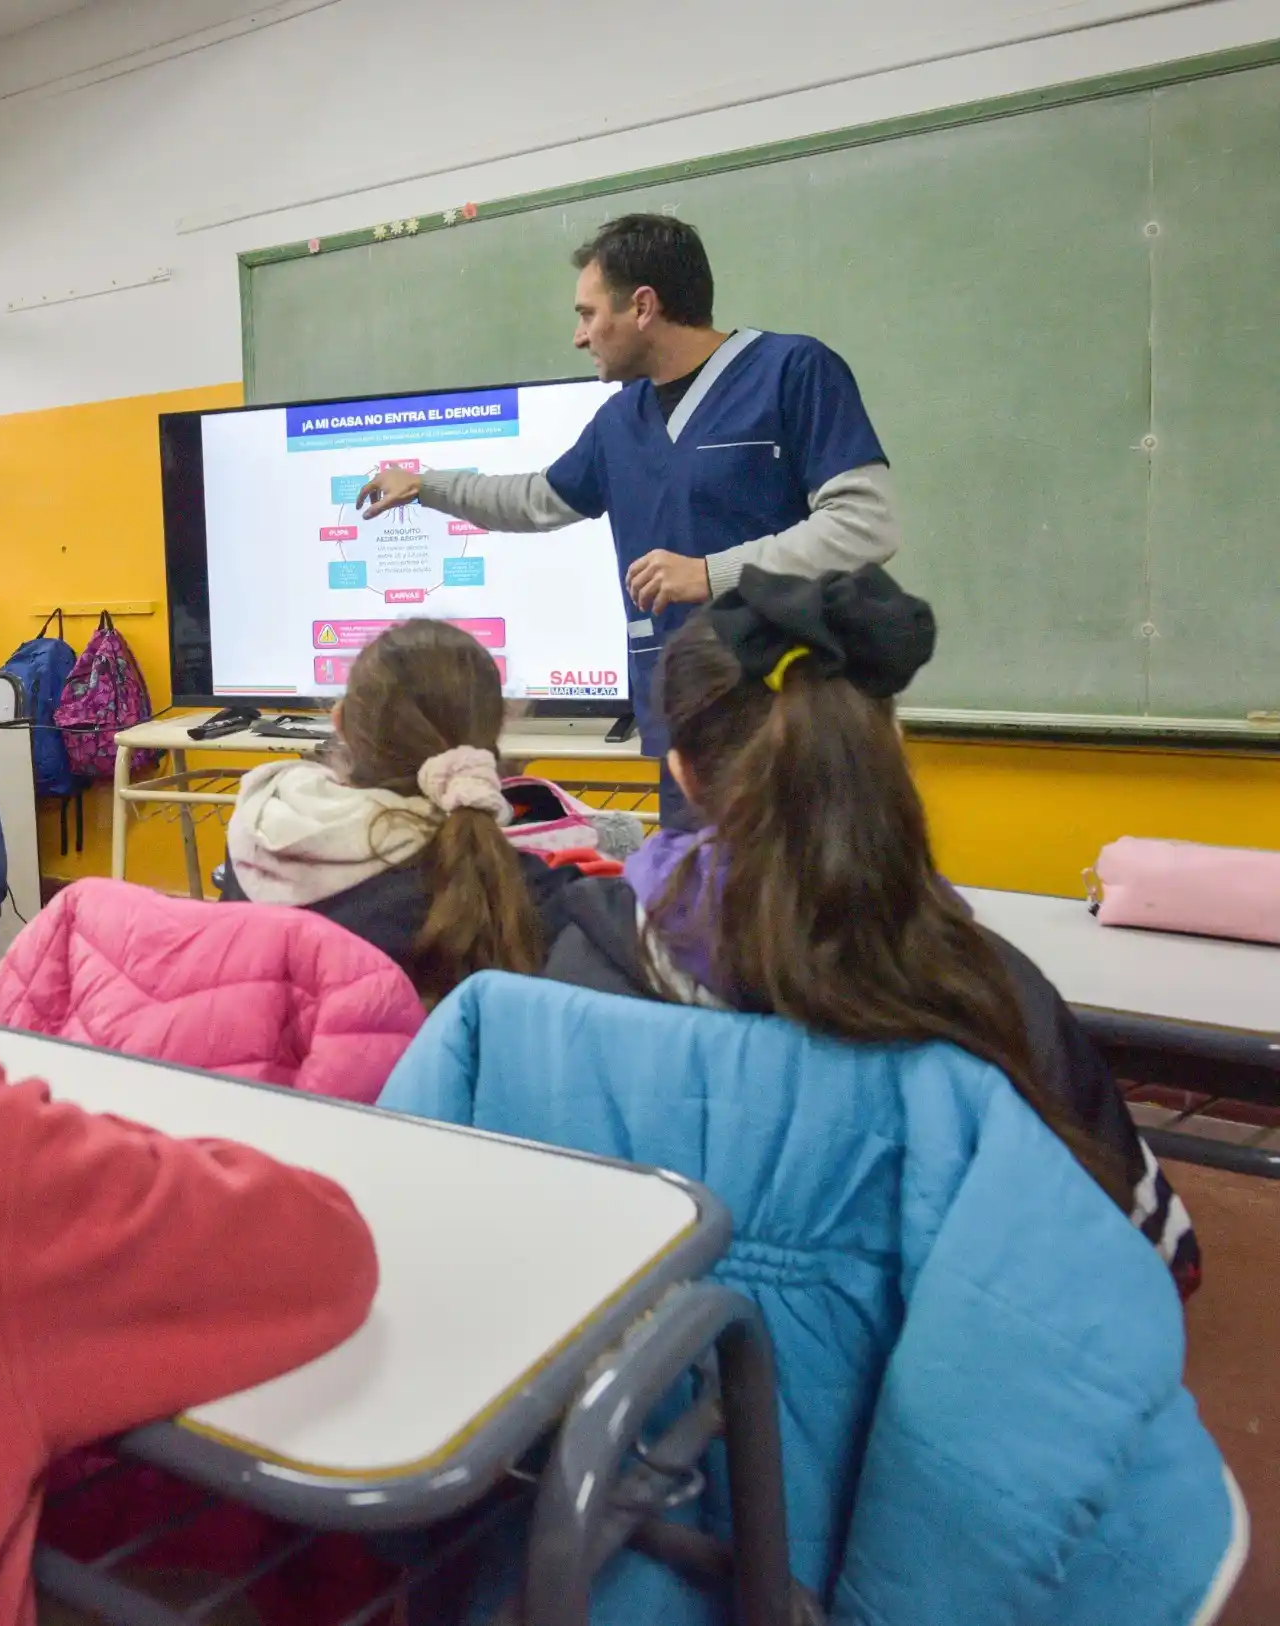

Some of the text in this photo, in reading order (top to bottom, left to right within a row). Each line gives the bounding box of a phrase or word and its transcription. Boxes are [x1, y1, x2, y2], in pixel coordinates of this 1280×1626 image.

[302, 404, 502, 433] ¡A MI CASA NO ENTRA EL DENGUE!
[550, 670, 618, 685] SALUD
[551, 687, 617, 695] MAR DEL PLATA
